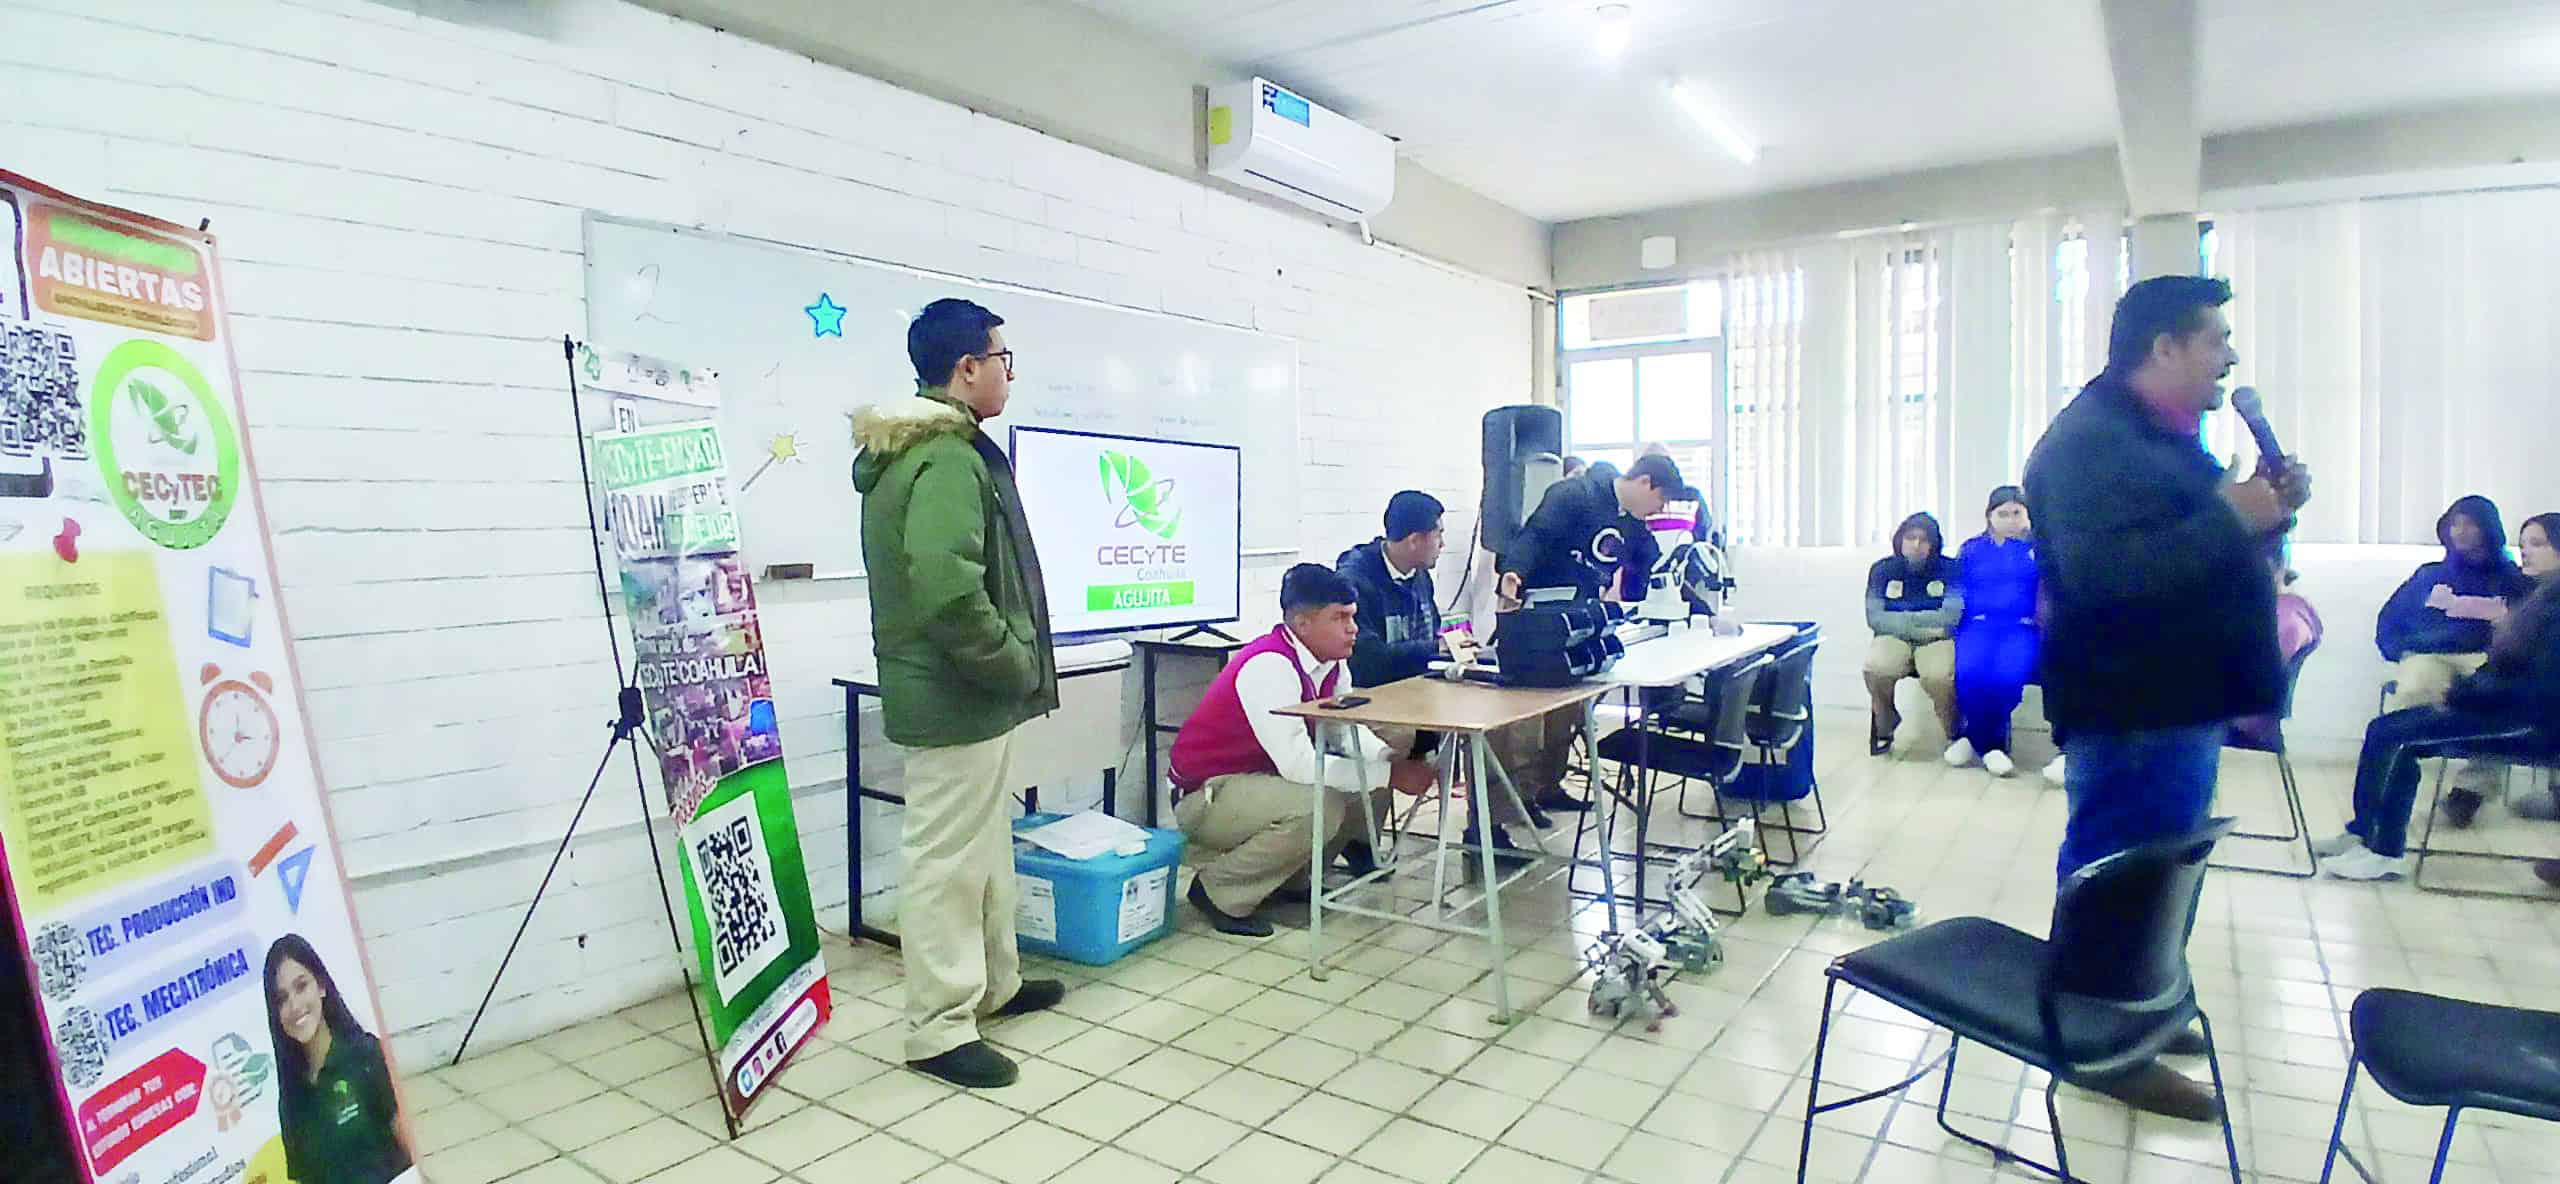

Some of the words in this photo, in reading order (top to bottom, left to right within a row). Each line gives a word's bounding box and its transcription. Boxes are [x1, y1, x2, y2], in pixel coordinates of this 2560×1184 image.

[39, 246, 203, 311] ABIERTAS
[121, 472, 223, 505] CECyTEC
[1113, 588, 1172, 610] AGUJITA
[678, 652, 765, 686] COAHUILA!
[86, 926, 120, 957] TEC.
[121, 884, 210, 944] PRODUCCIÓN
[106, 1003, 142, 1041] TEC.
[142, 948, 249, 1024] MECATRÓNICA
